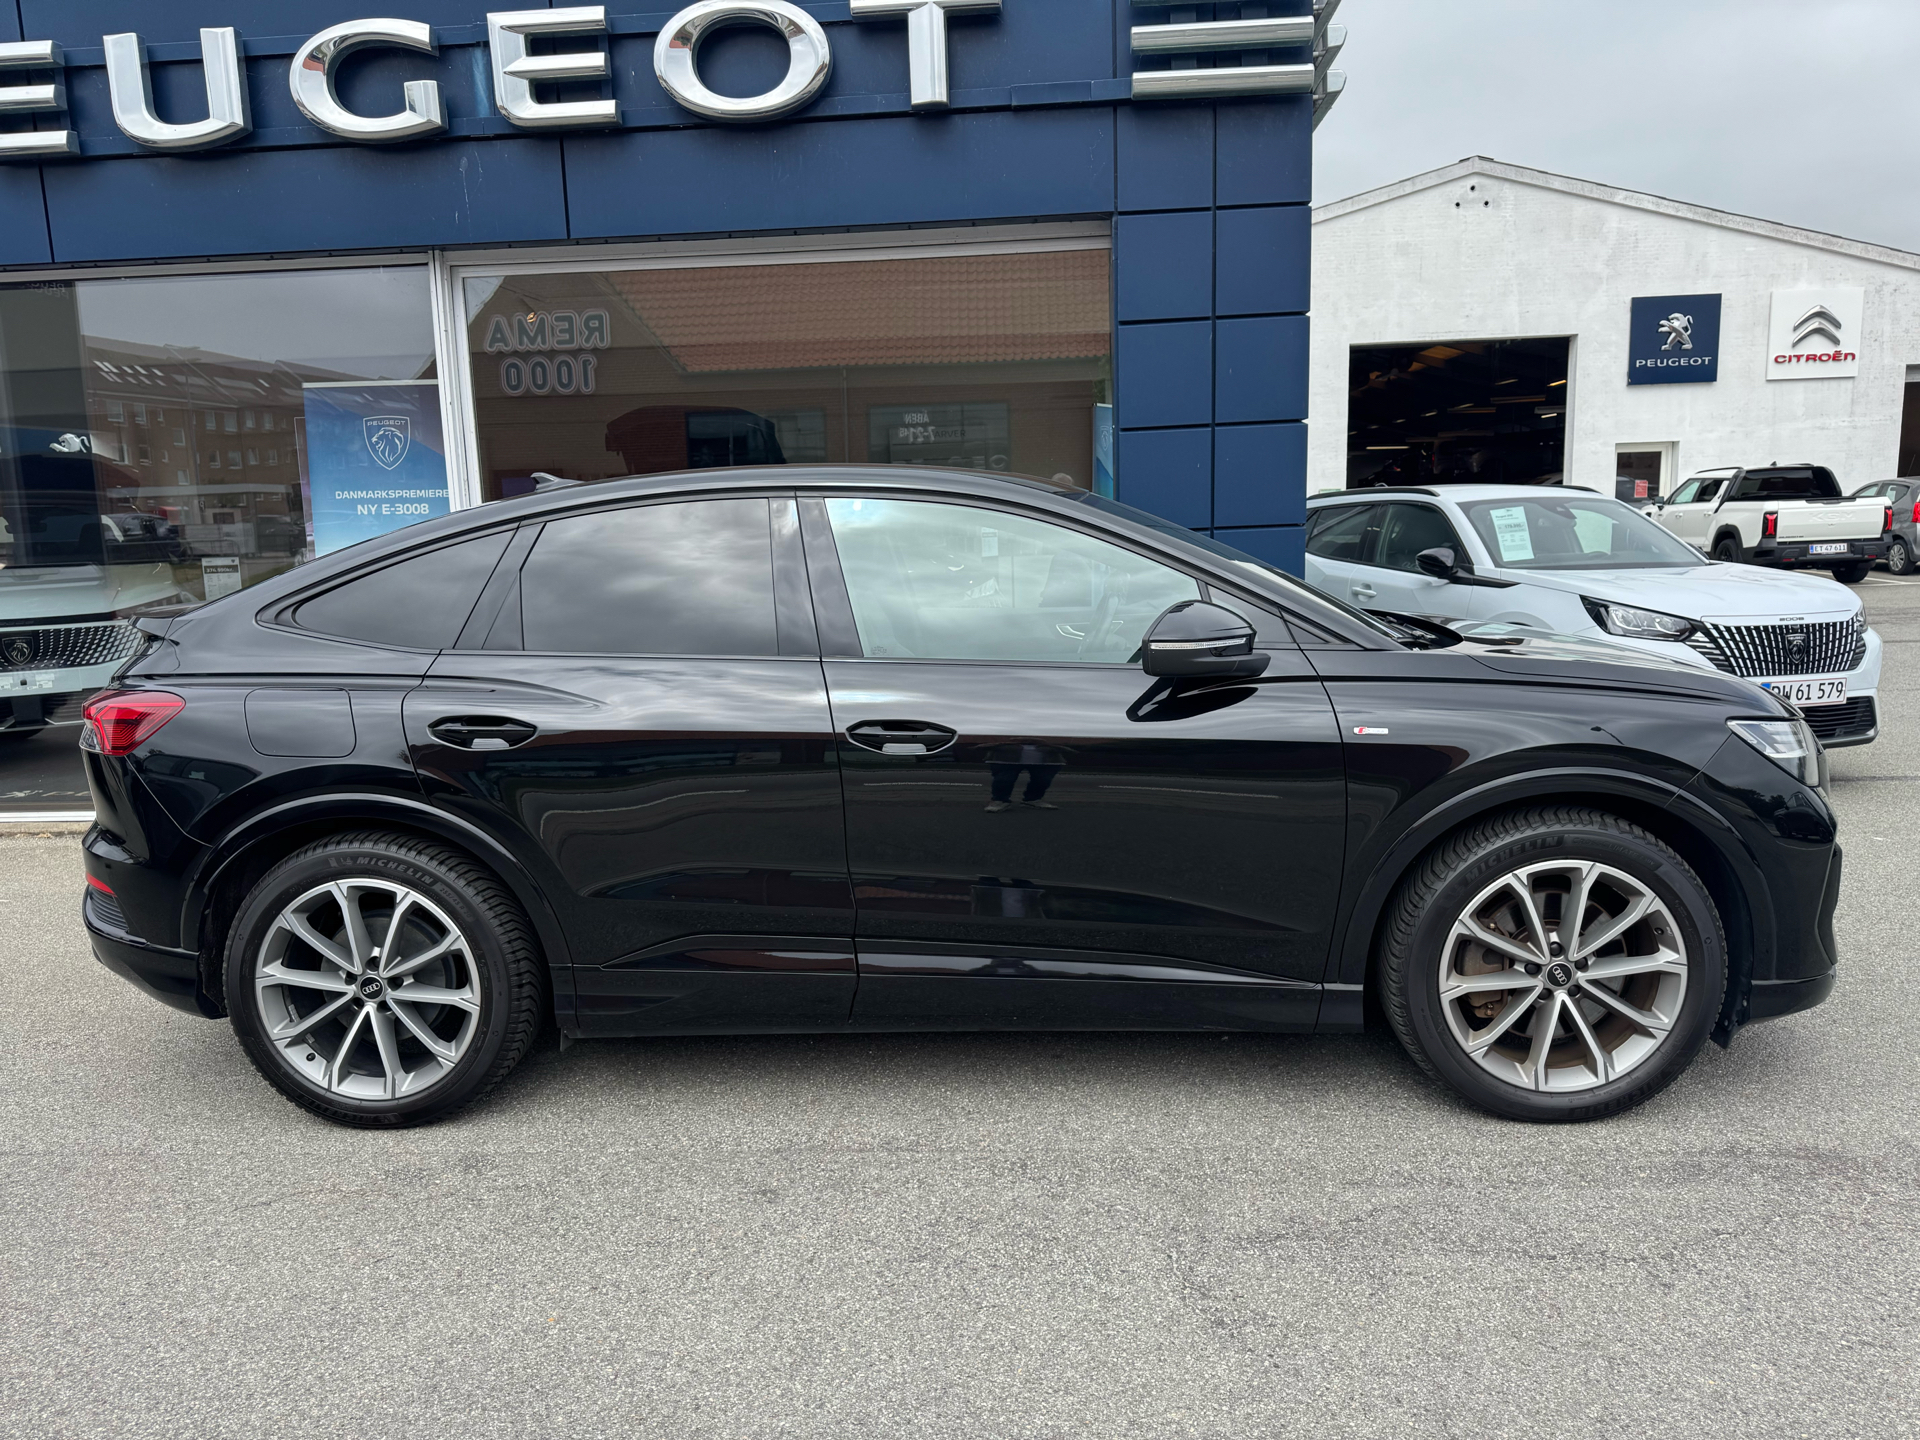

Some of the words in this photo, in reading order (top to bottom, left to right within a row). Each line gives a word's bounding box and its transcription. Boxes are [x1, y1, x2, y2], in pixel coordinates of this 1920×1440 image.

[1636, 356, 1712, 367] PEUGEOT
[335, 489, 449, 499] DANMARKSPREMIERE
[357, 504, 378, 515] NY
[382, 503, 429, 515] E-3008
[1795, 683, 1811, 701] 61
[1817, 681, 1844, 699] 579
[1465, 837, 1558, 881] MICHELIN
[357, 857, 434, 884] MICHELIN
